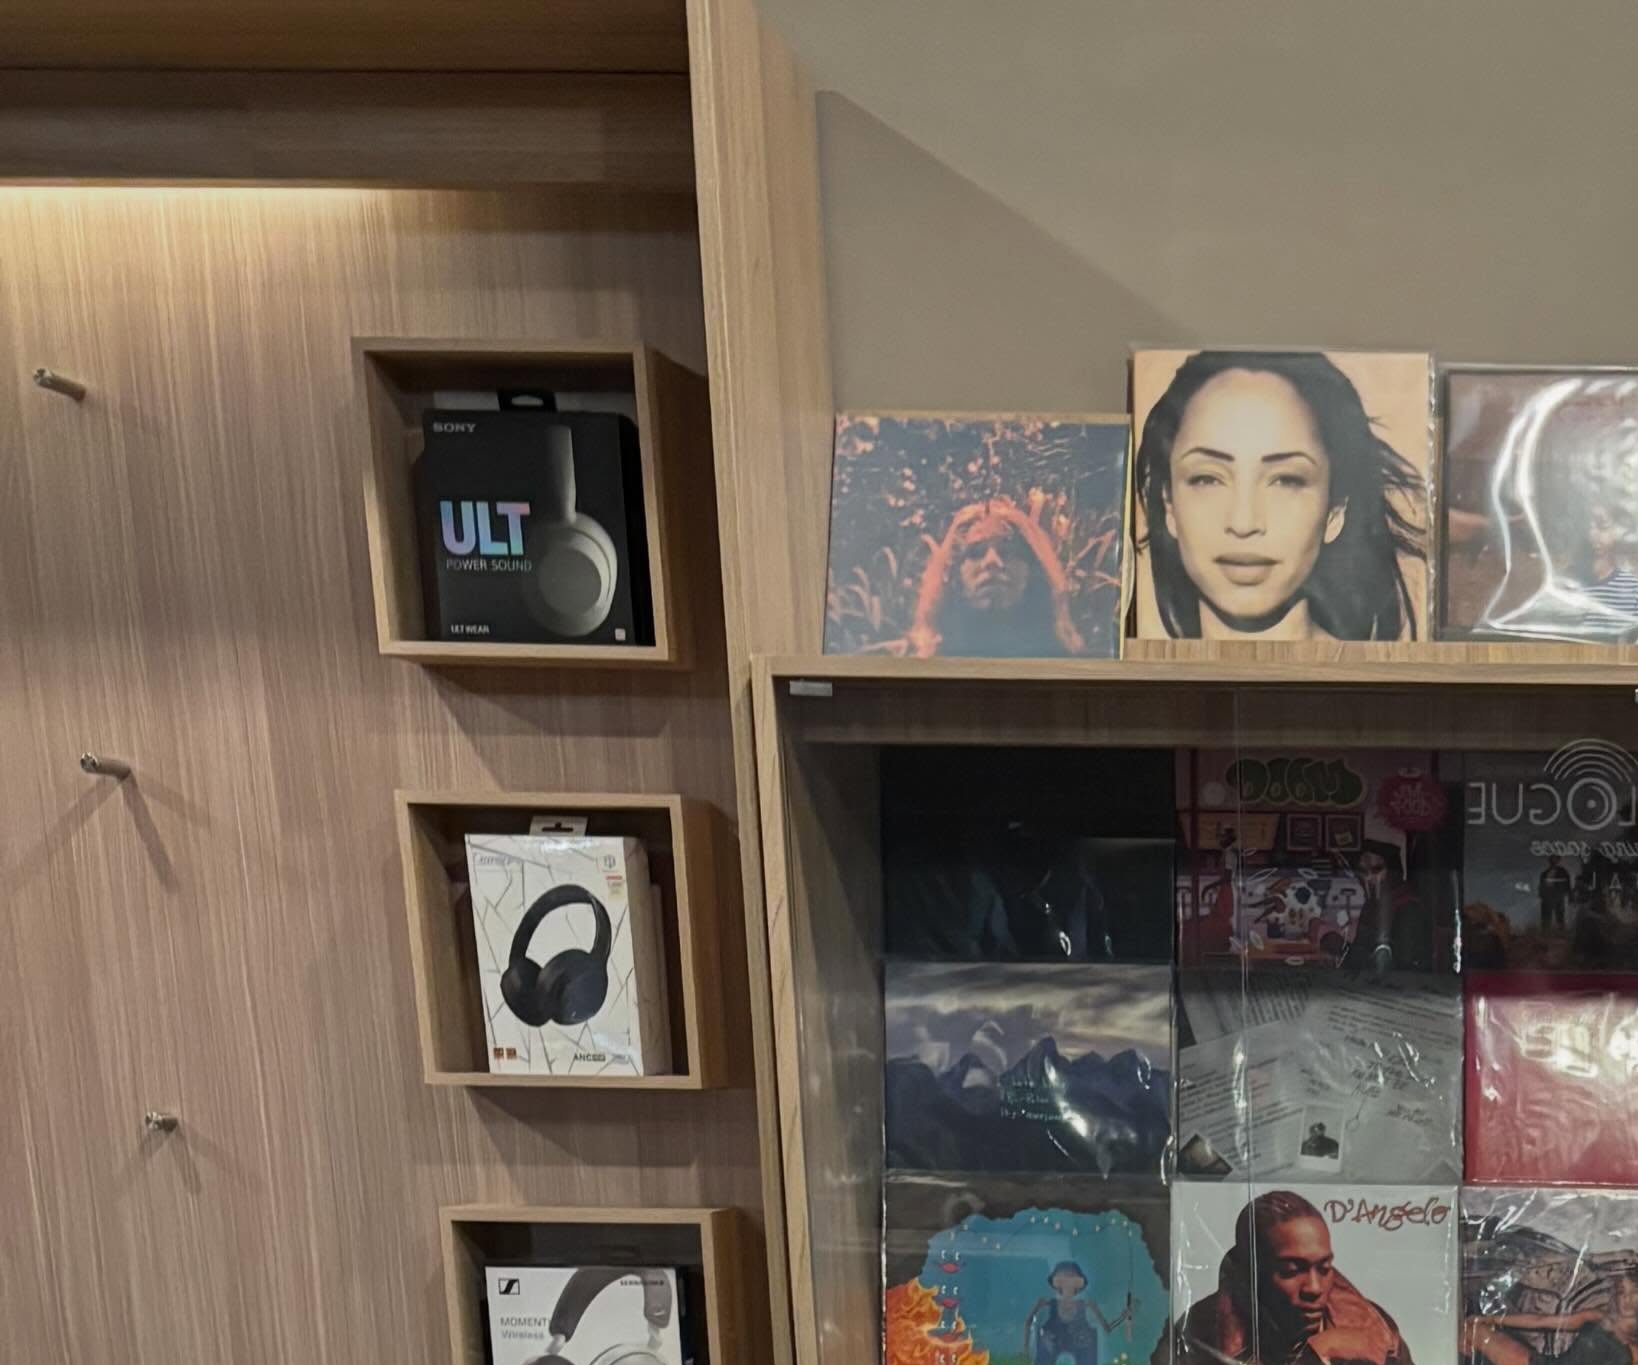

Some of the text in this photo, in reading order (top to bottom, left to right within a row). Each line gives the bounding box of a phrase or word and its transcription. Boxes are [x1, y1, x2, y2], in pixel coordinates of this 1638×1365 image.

[432, 422, 477, 433] SONY
[440, 500, 532, 556] ULT
[446, 559, 533, 572] POWER SOUND
[1323, 1197, 1451, 1231] D'Angelo
